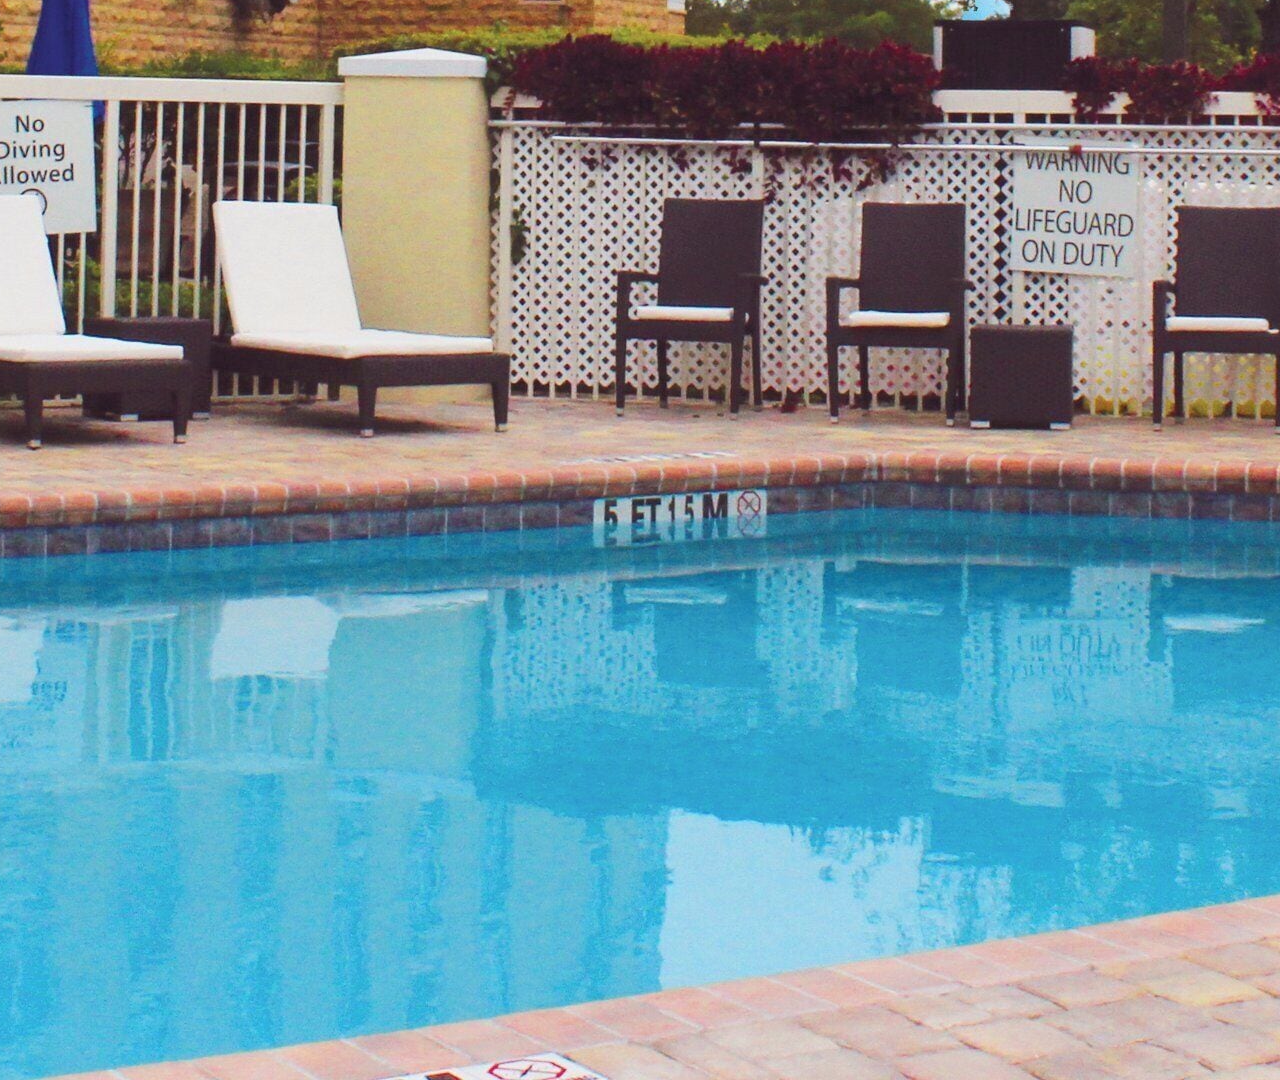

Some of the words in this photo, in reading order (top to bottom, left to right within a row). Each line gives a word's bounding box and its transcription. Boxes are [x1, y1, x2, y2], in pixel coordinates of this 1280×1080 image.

[15, 115, 44, 133] No
[1025, 152, 1130, 175] WARNING
[1059, 180, 1093, 204] NO
[1015, 209, 1134, 237] LIFEGUARD
[1022, 240, 1056, 264] ON
[1063, 242, 1124, 267] DUTY
[703, 493, 728, 519] M
